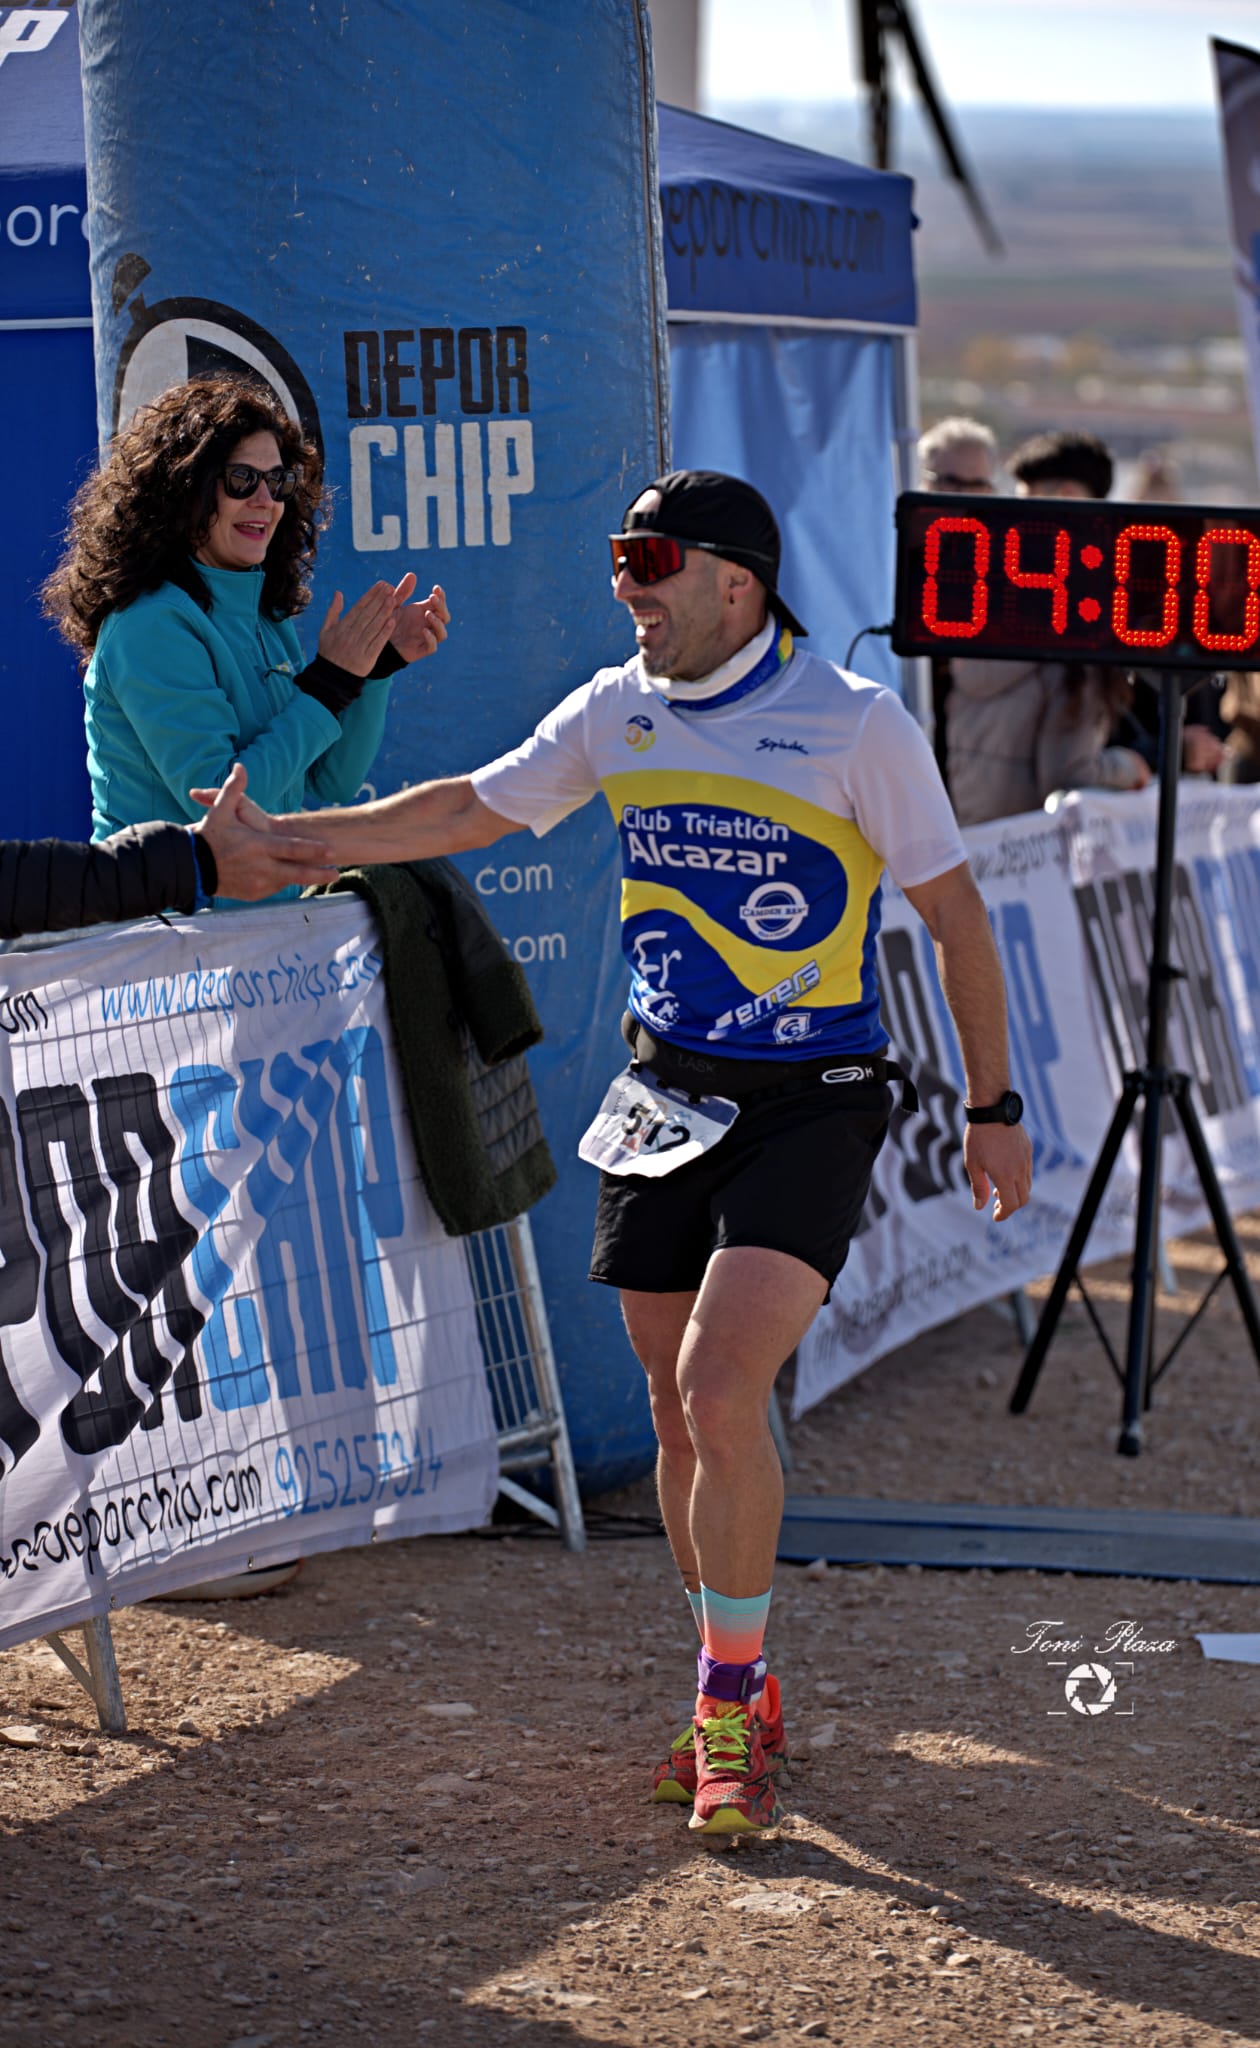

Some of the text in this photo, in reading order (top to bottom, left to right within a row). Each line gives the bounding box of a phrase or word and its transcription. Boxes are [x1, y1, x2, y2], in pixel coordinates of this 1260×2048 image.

[344, 326, 530, 418] DEPOR
[350, 420, 534, 552] CHIP
[623, 806, 790, 842] Club Triatlón
[628, 832, 788, 876] Alcazar
[475, 863, 553, 895] com
[502, 932, 567, 963] om
[273, 1428, 442, 1519] 925257314
